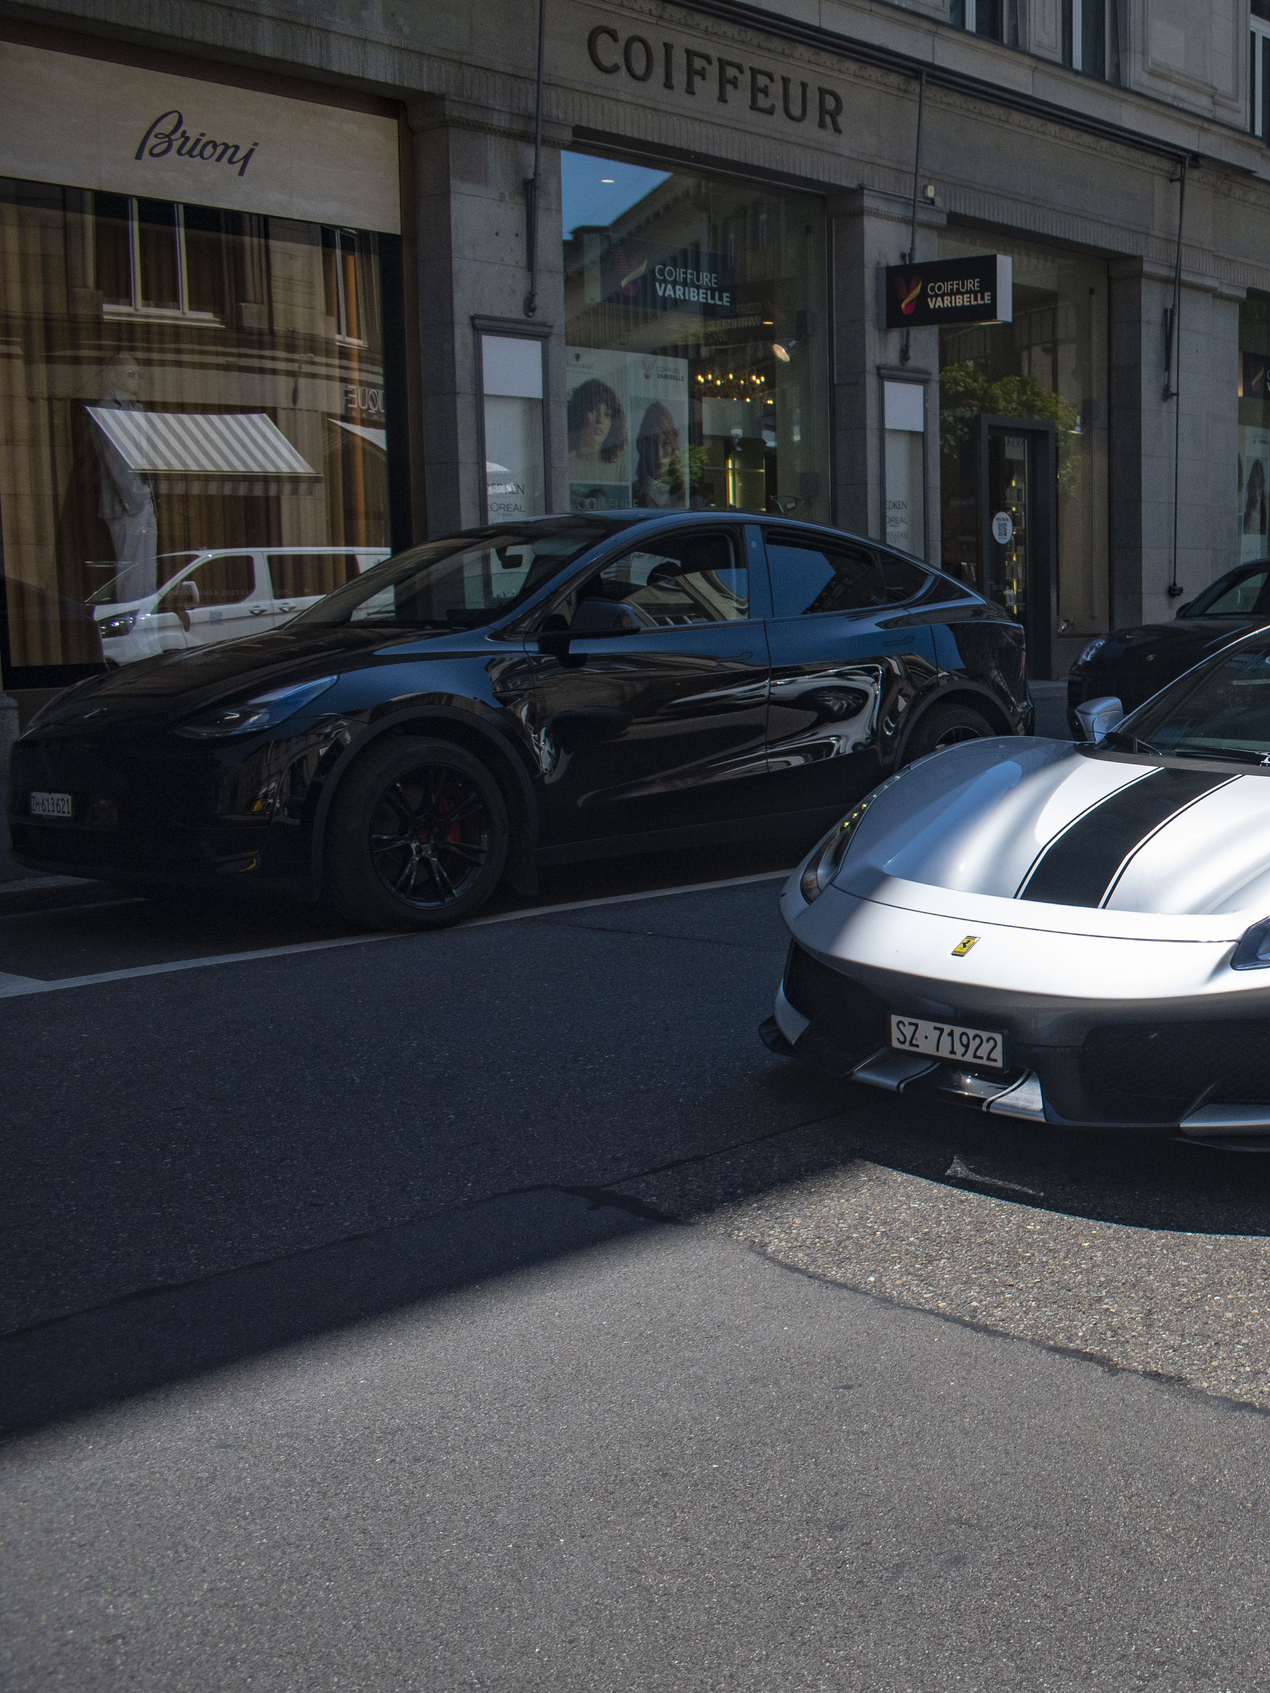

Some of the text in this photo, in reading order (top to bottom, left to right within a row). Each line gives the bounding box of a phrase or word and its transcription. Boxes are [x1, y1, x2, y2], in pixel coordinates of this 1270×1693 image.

[587, 24, 844, 134] COIFFEUR
[134, 110, 259, 177] Brioni
[654, 264, 718, 288] COIFFURE
[927, 278, 981, 296] COIFFURE
[654, 281, 731, 307] VARIBELLE
[927, 291, 992, 310] VARIBELLE
[886, 500, 908, 510] EDKEN
